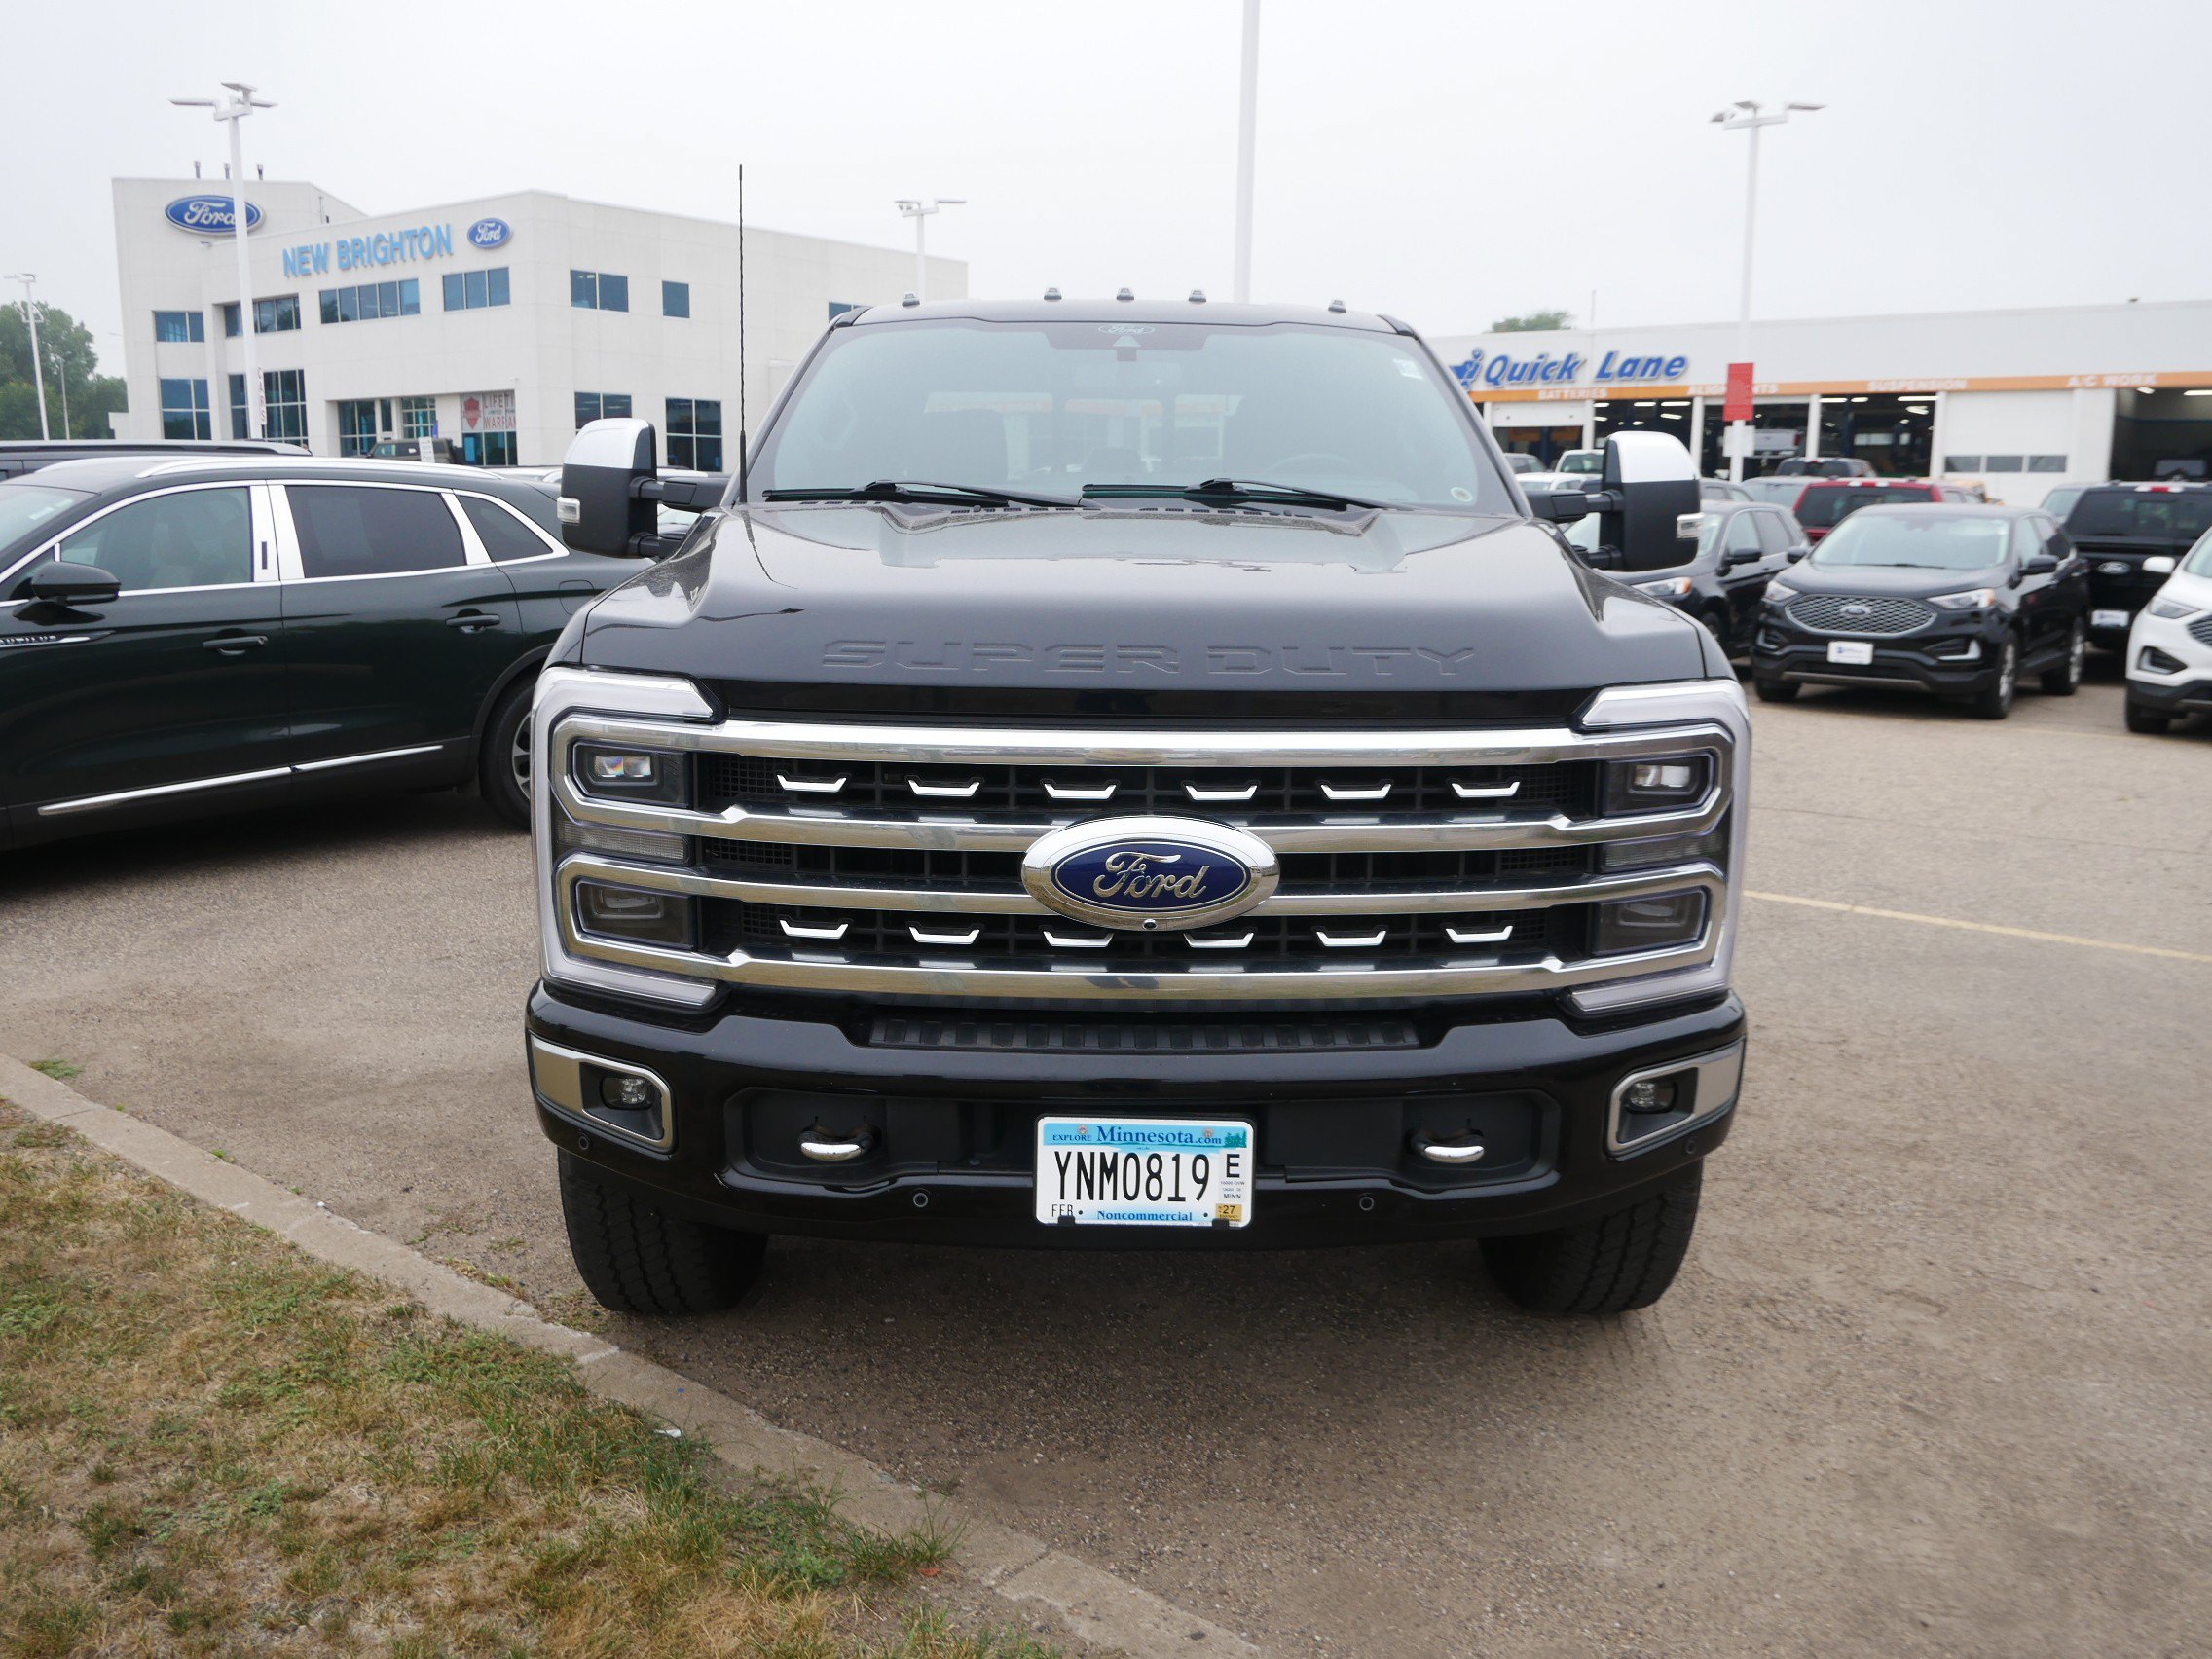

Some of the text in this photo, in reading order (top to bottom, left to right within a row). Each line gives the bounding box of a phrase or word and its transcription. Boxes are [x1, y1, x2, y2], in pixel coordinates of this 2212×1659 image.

[476, 222, 502, 243] Ford
[282, 224, 454, 277] NEW BRIGHTON
[1485, 350, 1689, 387] Quick Lane
[1537, 388, 1608, 400] BATTERIES
[1868, 379, 1968, 391] SUSPENSION
[823, 640, 1474, 676] SUPER DUTY
[1093, 851, 1210, 899] Ford
[1054, 1151, 1210, 1202] YNM0819
[1226, 1154, 1240, 1178] E
[1051, 1203, 1073, 1217] FEB
[1097, 1210, 1193, 1221] Noncommercial
[1223, 1205, 1235, 1215] 27
